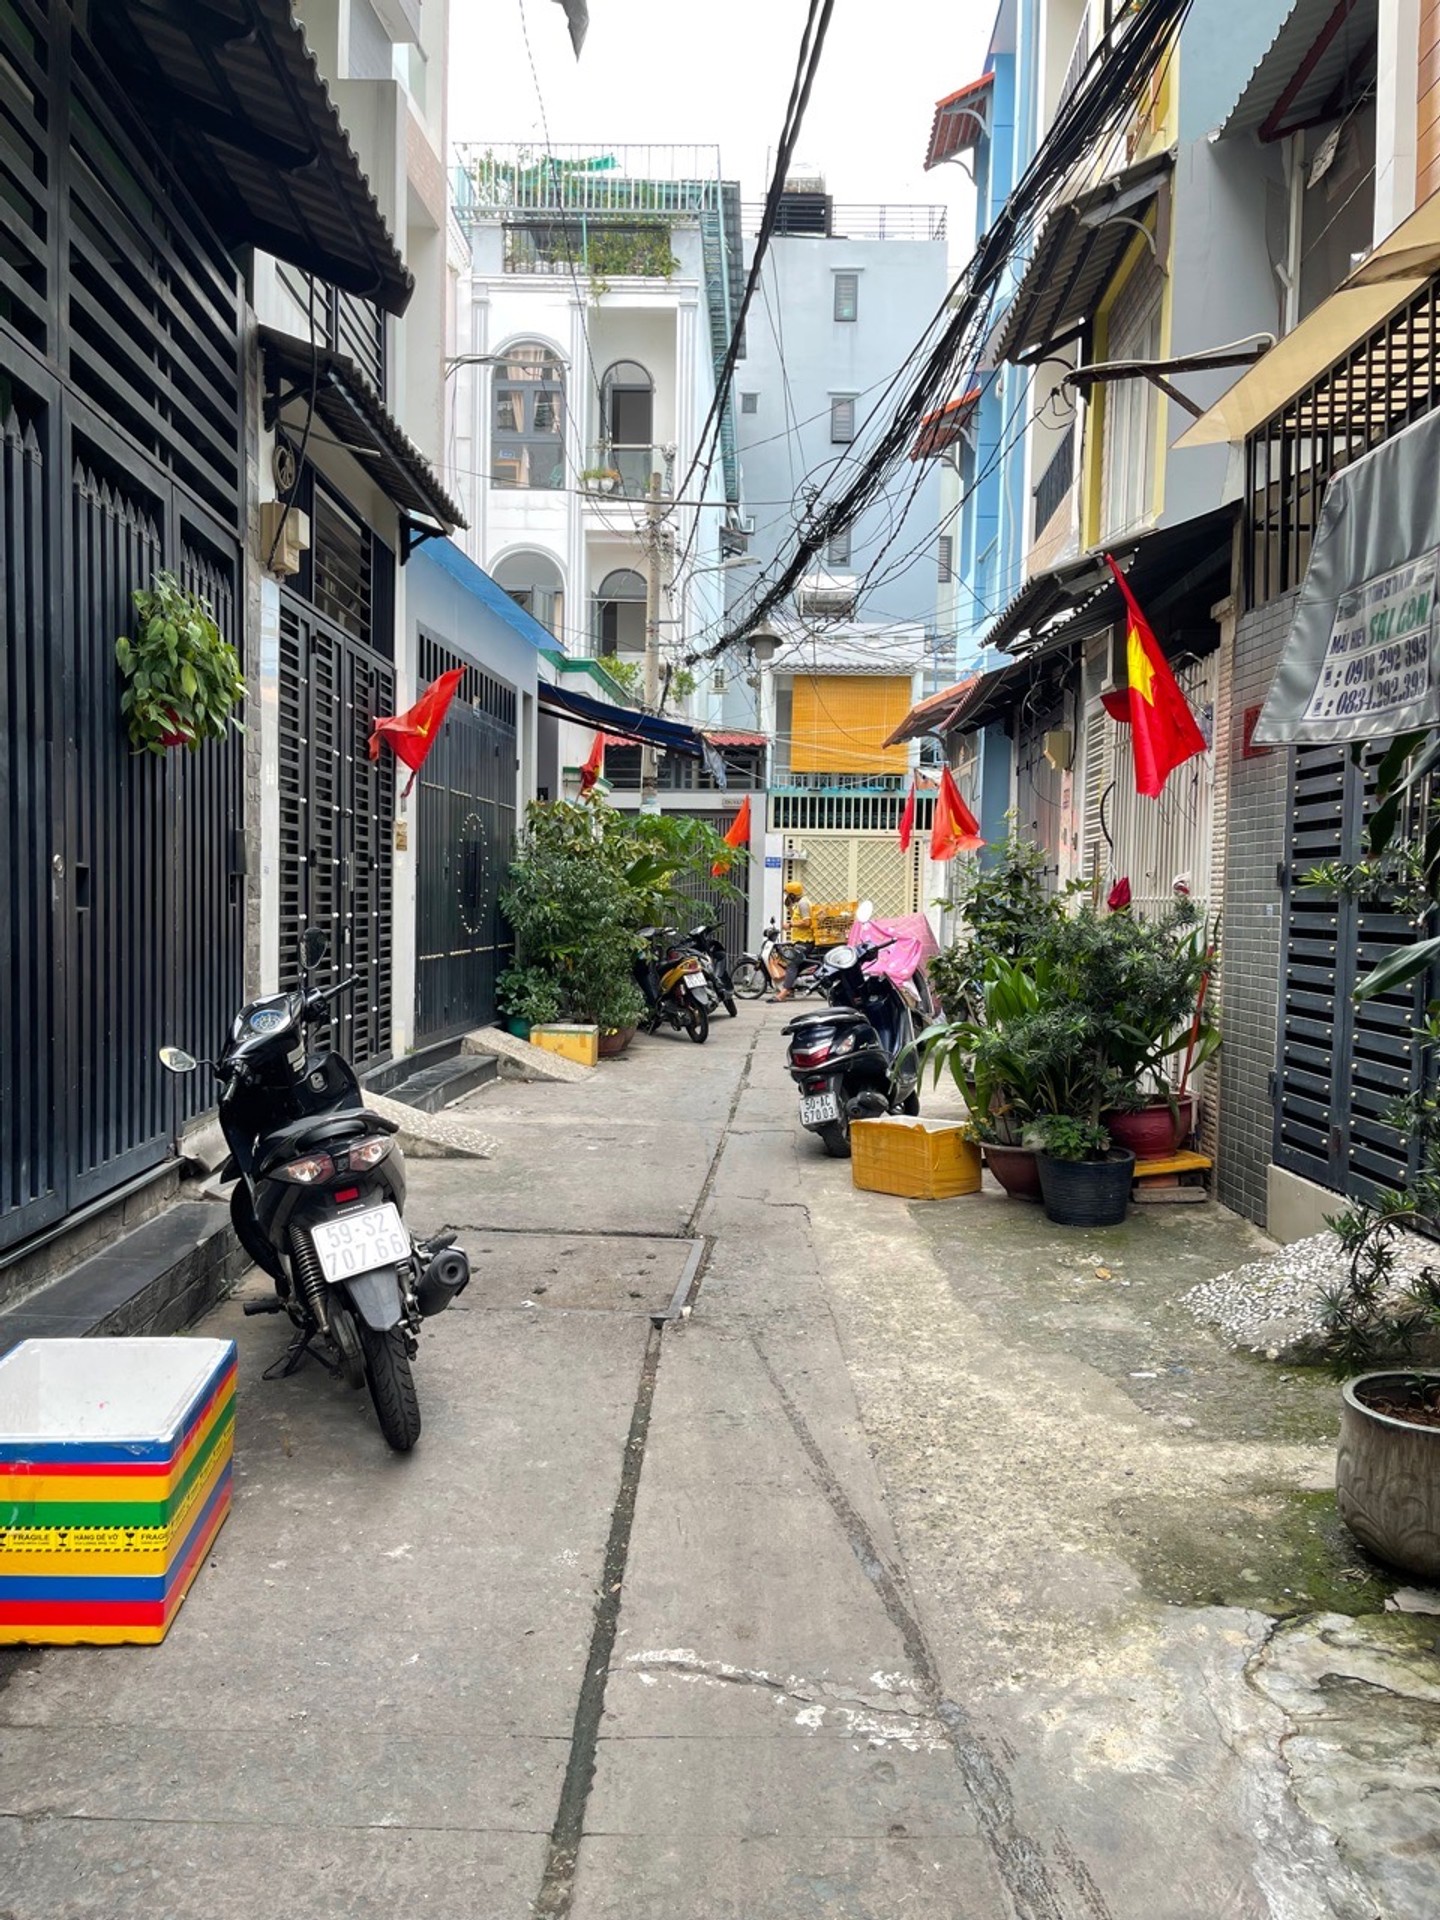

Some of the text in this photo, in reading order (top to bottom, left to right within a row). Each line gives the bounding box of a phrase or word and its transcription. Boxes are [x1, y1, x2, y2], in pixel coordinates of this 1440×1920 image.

[1345, 633, 1428, 687] 0918 292 393
